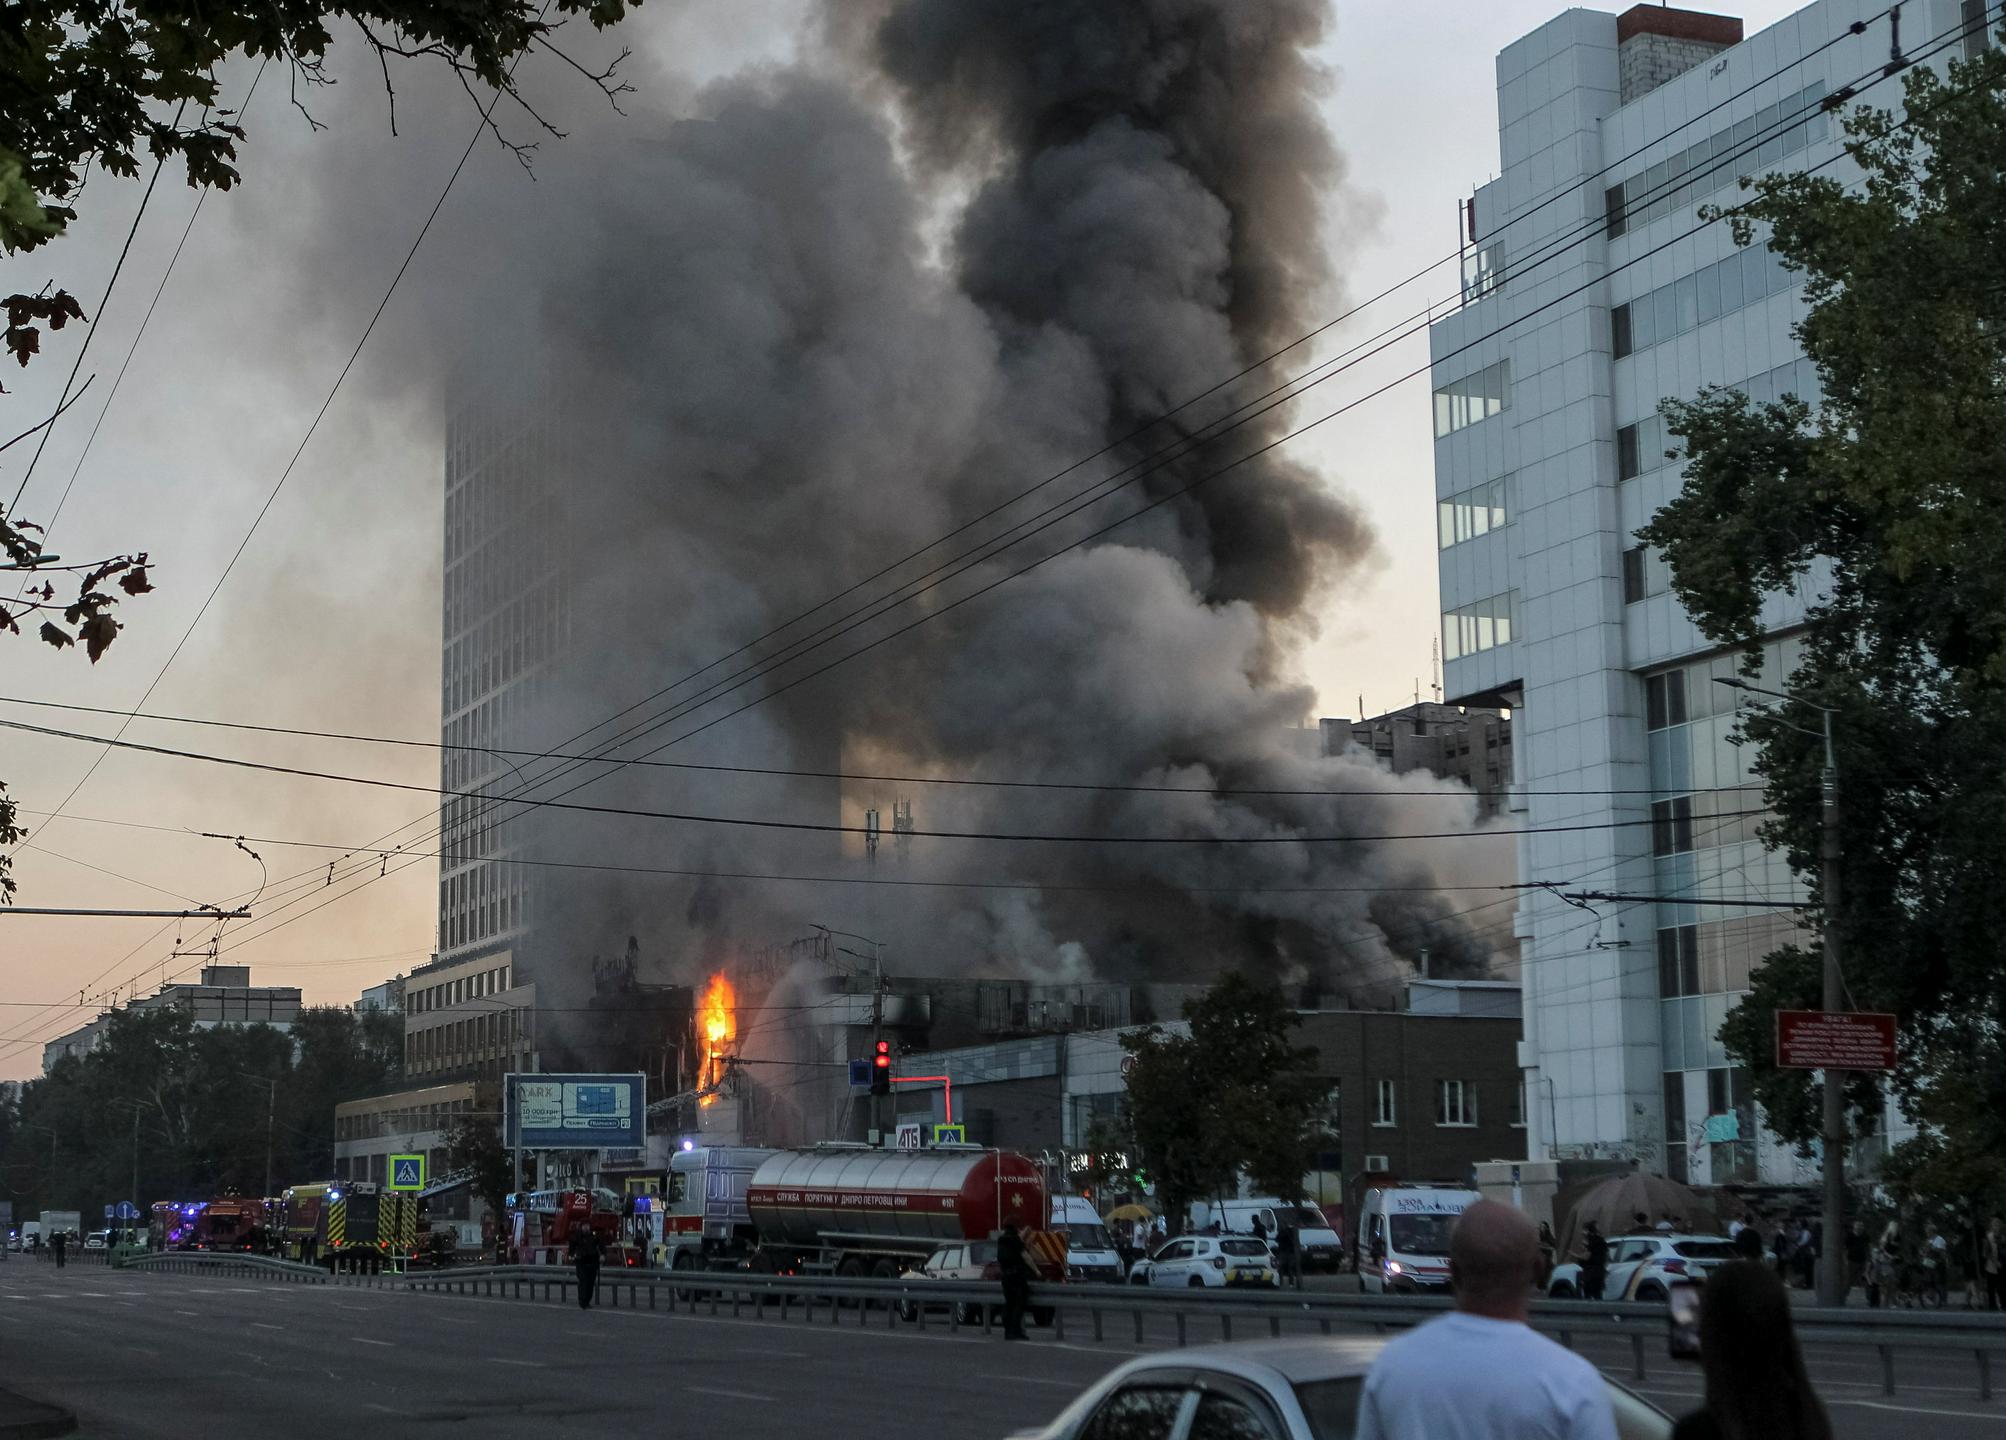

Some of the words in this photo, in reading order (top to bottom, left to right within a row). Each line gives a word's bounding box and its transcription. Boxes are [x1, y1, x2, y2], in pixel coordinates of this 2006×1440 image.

[575, 1193, 587, 1204] 25
[777, 1192, 800, 1202] СЛУЖБА
[804, 1193, 839, 1204] ПОРЯТУНКУ
